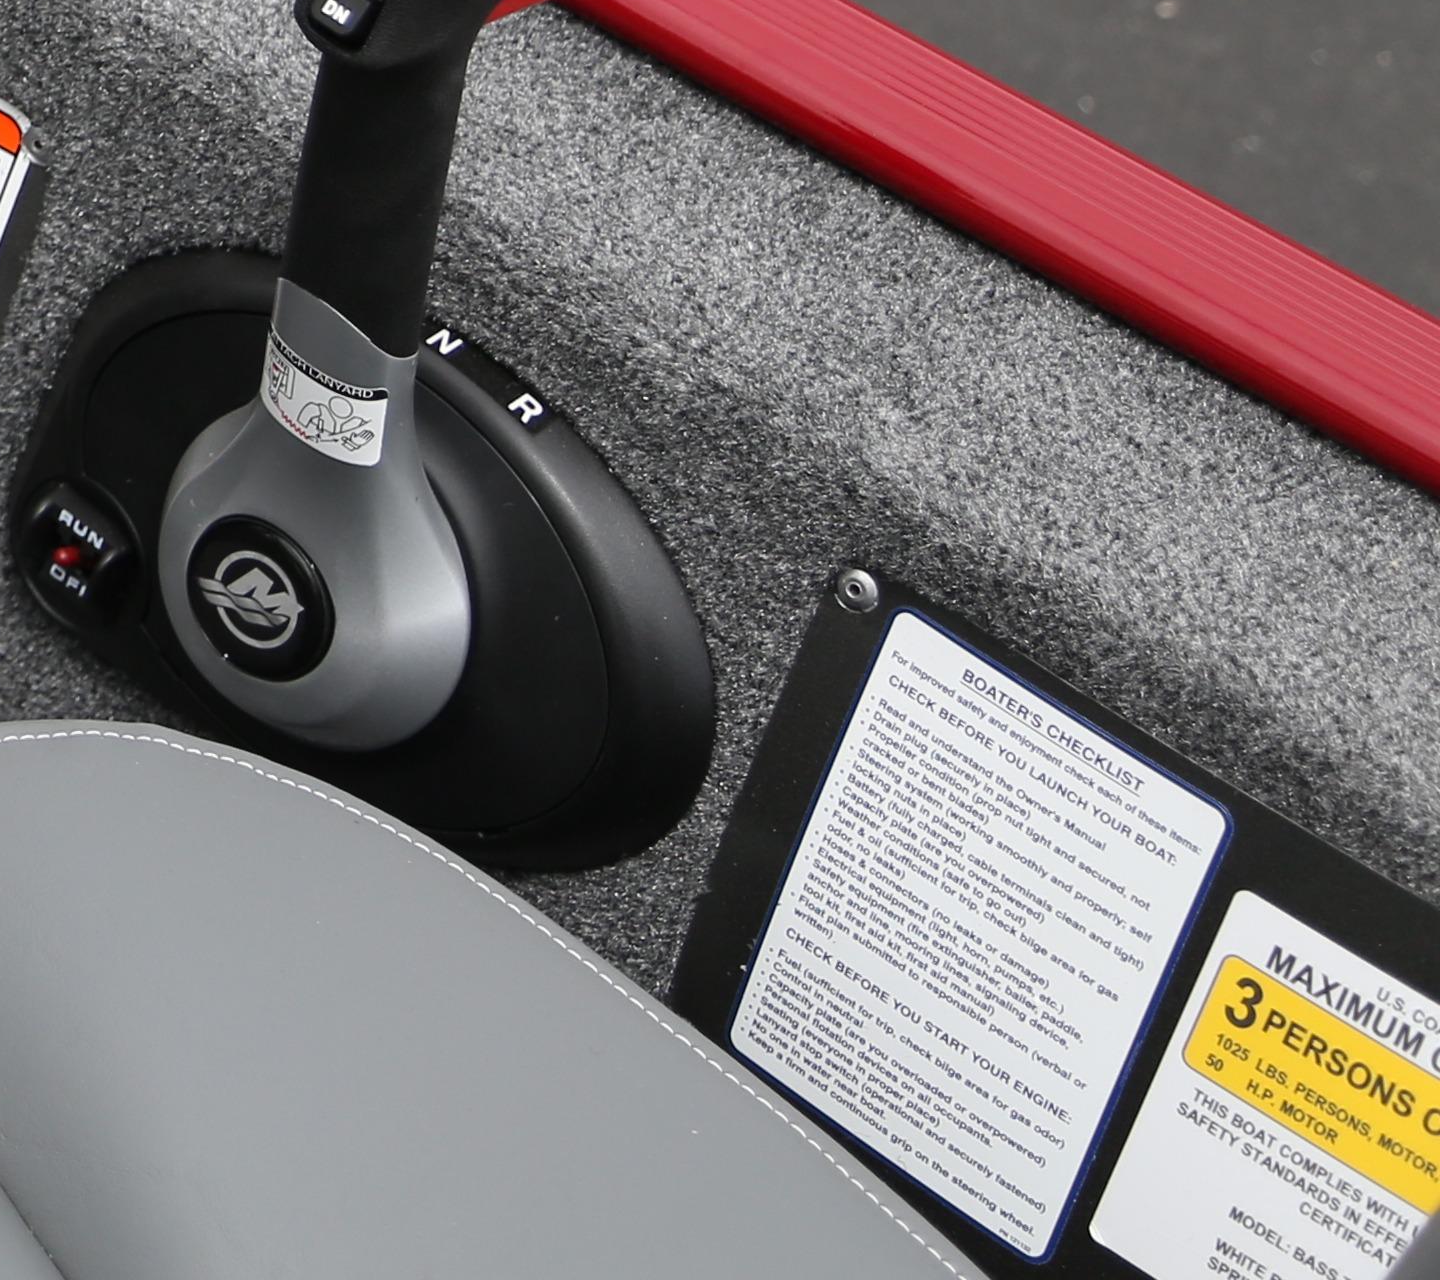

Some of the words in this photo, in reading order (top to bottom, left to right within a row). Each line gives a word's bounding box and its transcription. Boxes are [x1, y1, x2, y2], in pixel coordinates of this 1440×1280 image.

[309, 366, 374, 399] LANYARD
[425, 328, 464, 355] N
[507, 392, 543, 424] R
[58, 508, 104, 550] RUN
[873, 710, 901, 735] Drain
[902, 732, 928, 754] plug
[930, 749, 981, 787] (securely
[982, 782, 994, 795] in
[995, 793, 1030, 820] place)
[878, 698, 907, 721] Read
[908, 719, 929, 737] and
[931, 735, 993, 779] understand
[995, 775, 1013, 792] the
[1015, 788, 1060, 822] Owner's
[1063, 818, 1106, 850] Manual
[888, 675, 936, 712] CHECK
[938, 707, 994, 750] BEFORE
[998, 744, 1026, 770] YOU
[1028, 766, 1088, 810] LAUNCH
[1092, 805, 1131, 837] YOUR
[1134, 833, 1176, 865] BOAT:
[891, 650, 908, 666] For
[909, 662, 955, 697] improved
[956, 695, 987, 719] safety
[987, 715, 1008, 732] and
[1009, 730, 1062, 767] enjoyment
[1063, 764, 1095, 788] check
[1096, 785, 1122, 805] each
[1124, 803, 1137, 813] of
[1137, 809, 1167, 833] these
[1168, 829, 1201, 854] items:
[962, 668, 1042, 728] BOATER'S
[1046, 724, 1144, 790] CHECKLIST
[777, 948, 801, 971] Fuel
[803, 968, 856, 1009] (sufficient
[857, 1004, 873, 1019] for
[875, 1016, 895, 1038] trip,
[899, 1035, 932, 1061] check
[934, 1057, 962, 1080] bilge
[964, 1078, 989, 1099] area
[991, 1095, 1008, 1110] for
[1009, 1109, 1031, 1126] gas
[1033, 1124, 1064, 1149] odor)
[786, 927, 832, 964] CHECK
[834, 960, 889, 1003] BEFORE
[893, 998, 921, 1024] YOU
[923, 1020, 969, 1054] START
[972, 1051, 1010, 1084] YOUR
[1013, 1079, 1071, 1124] ENGINE:
[1224, 977, 1264, 1029] 3
[1262, 1008, 1416, 1118] PERSONS
[1265, 944, 1425, 1058] MAXIMUM
[1376, 987, 1407, 1015] U.S.
[1205, 1053, 1224, 1072] 50
[1246, 1079, 1275, 1106] H.P.
[1279, 1100, 1340, 1145] MOTOR
[1216, 1033, 1250, 1062] 1025
[1255, 1058, 1289, 1088] LBS.
[1293, 1081, 1373, 1141] PERSONS,
[1377, 1133, 1440, 1183] MOTOR,
[1176, 1101, 1240, 1147] SAFETY
[1240, 1142, 1341, 1213] STANDARDS
[1343, 1205, 1362, 1225] IN
[1364, 1218, 1409, 1253] EFFE
[1194, 1087, 1228, 1120] THIS
[1231, 1113, 1278, 1149] BOAT
[1279, 1143, 1363, 1203] COMPLIES
[1366, 1196, 1410, 1232] WITH
[1215, 1237, 1268, 1279] WHITE
[1229, 1205, 1291, 1254] MODEL:
[1292, 1246, 1339, 1280] BASS
[1299, 1201, 1398, 1269] CERTIFICAT
